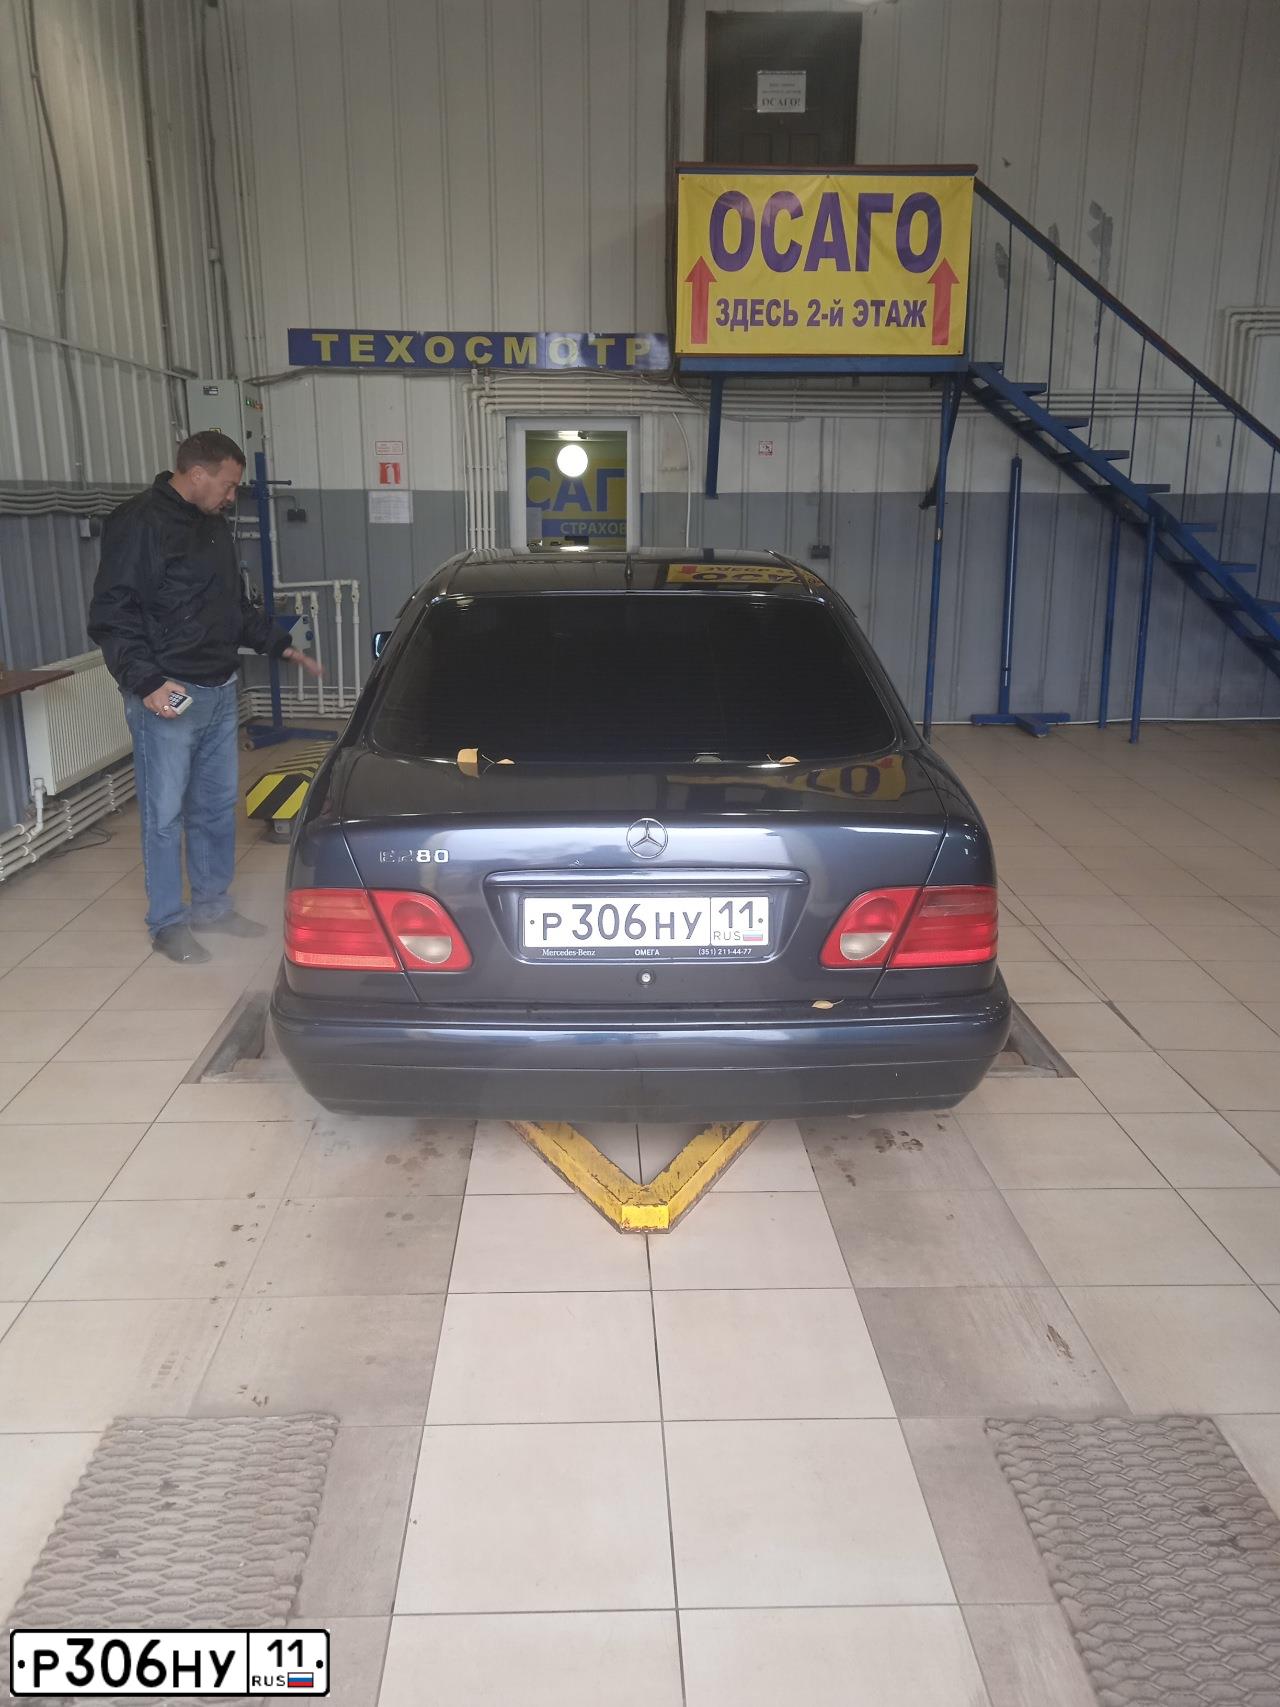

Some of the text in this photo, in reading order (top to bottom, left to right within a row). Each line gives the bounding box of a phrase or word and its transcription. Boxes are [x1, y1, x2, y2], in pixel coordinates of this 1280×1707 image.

[709, 190, 942, 273] ОСАГО
[715, 298, 927, 332] ЗДЕСЬ 2-й ЭТАЖ
[311, 333, 651, 367] ТЕХОСМОТР
[543, 900, 753, 941] Р306НУ 11
[713, 931, 741, 941] RUS
[542, 948, 596, 957] Mercedes-Benz
[634, 948, 660, 956] ОМЕГА
[698, 947, 752, 956] (351) 211-44-77
